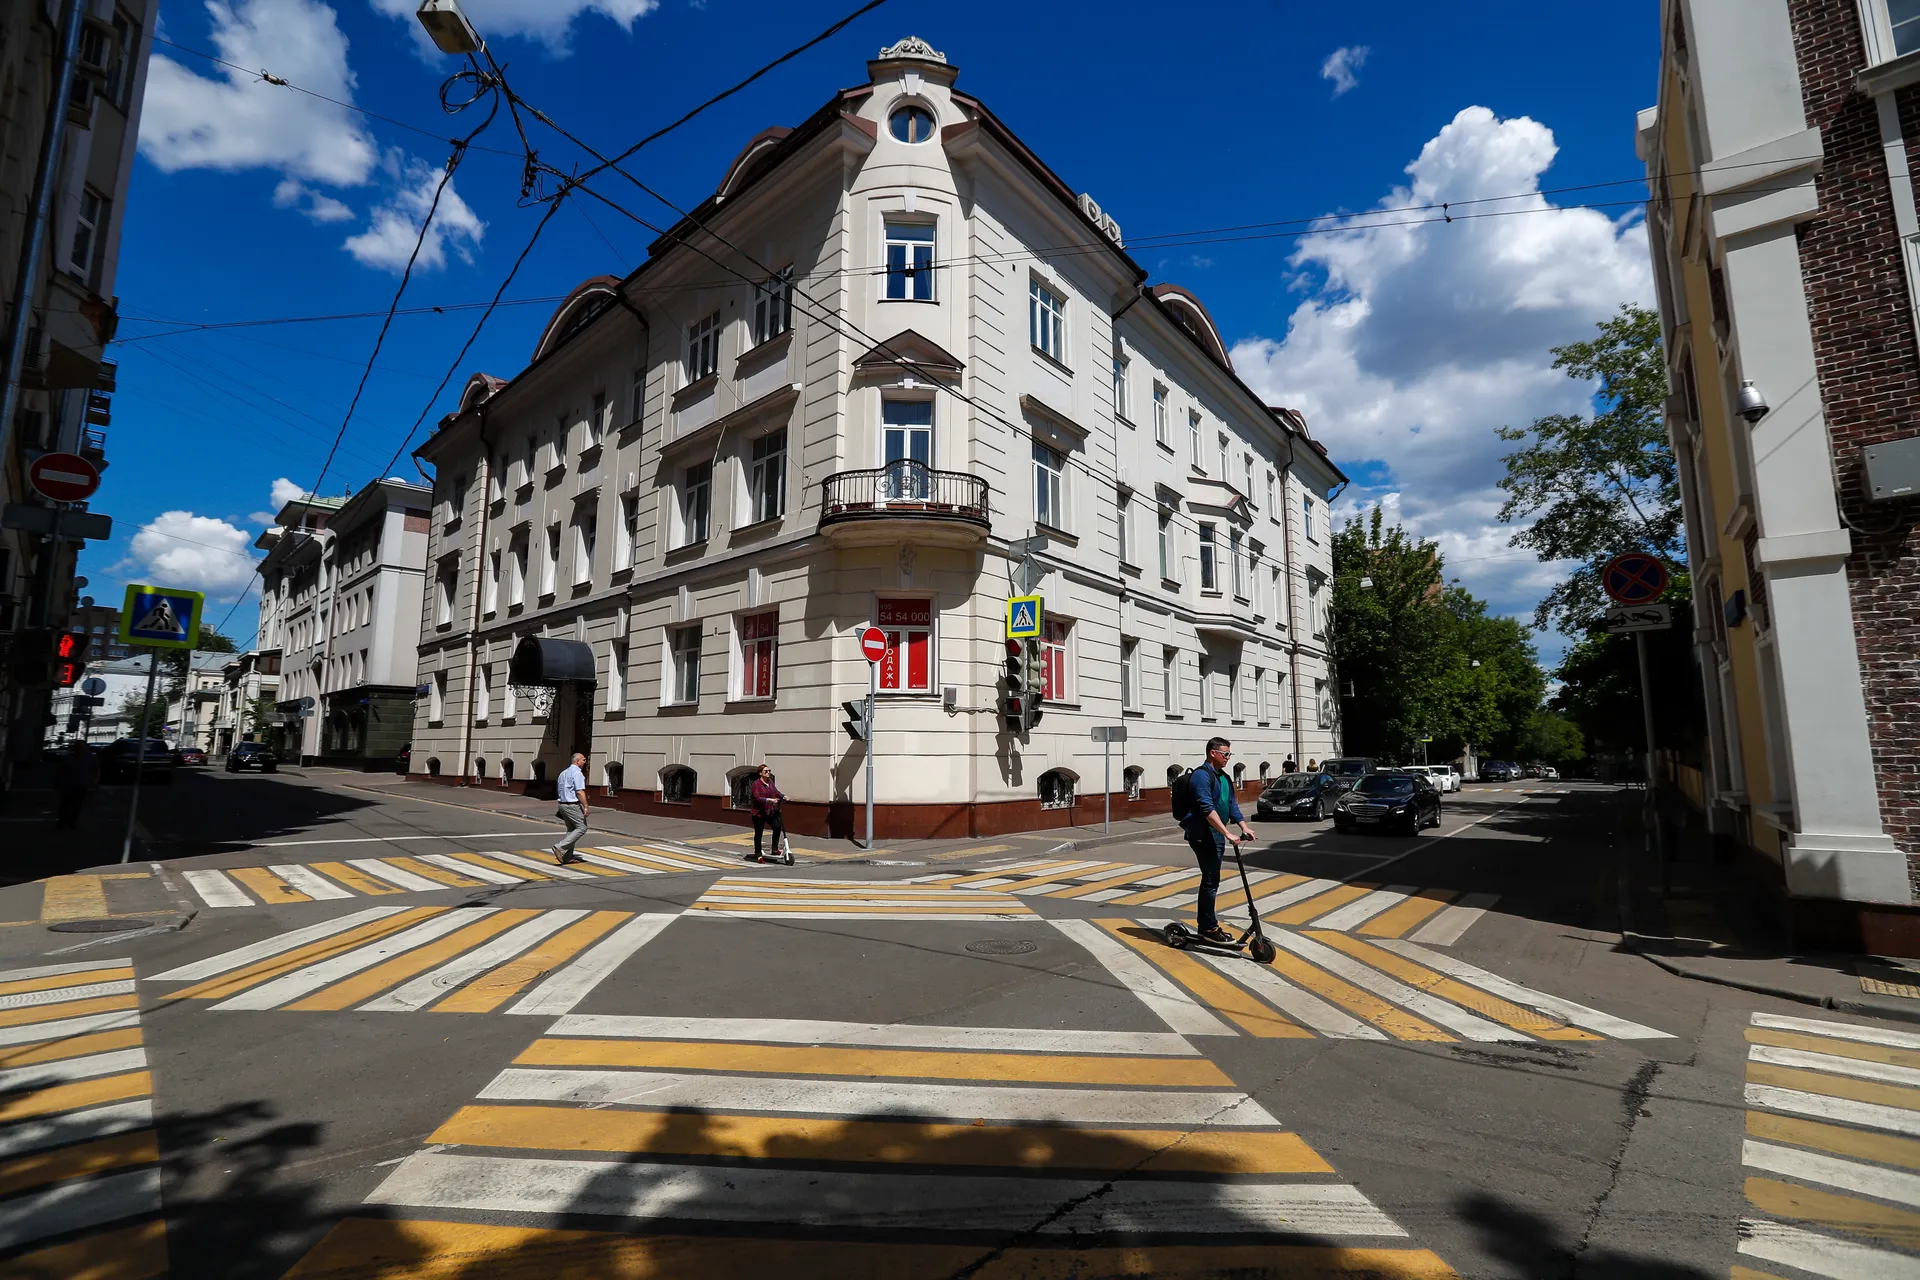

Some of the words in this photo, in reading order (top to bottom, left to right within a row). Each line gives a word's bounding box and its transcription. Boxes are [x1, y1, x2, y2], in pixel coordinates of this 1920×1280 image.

[880, 612, 892, 622] 54
[895, 612, 908, 622] 54
[910, 612, 930, 622] 000
[886, 632, 894, 688] ПРОДАЖА
[60, 664, 74, 685] 3
